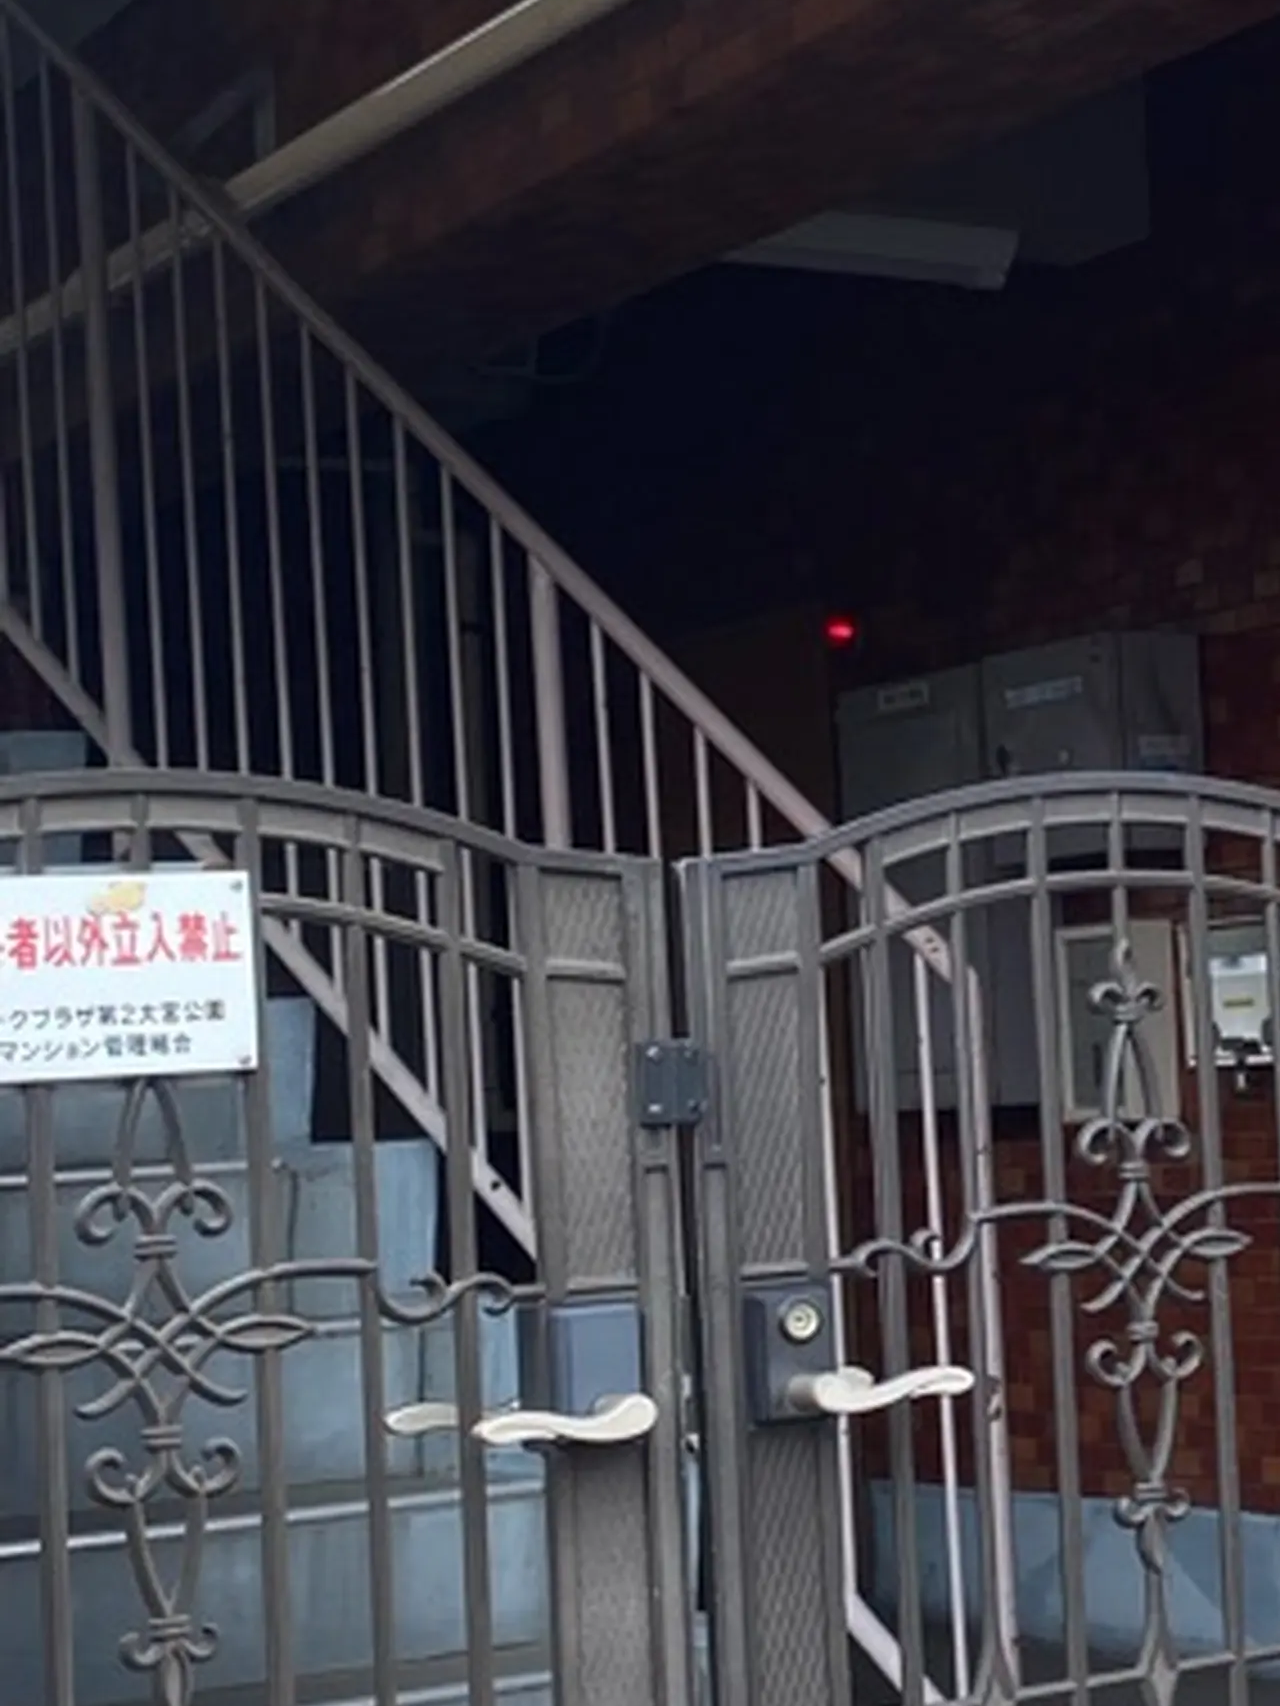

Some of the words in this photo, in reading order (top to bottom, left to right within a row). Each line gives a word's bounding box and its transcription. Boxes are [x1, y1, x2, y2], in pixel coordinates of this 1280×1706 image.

[0, 911, 241, 970] 者以外立入禁止
[0, 999, 226, 1030] クプラザ第2大宮公園
